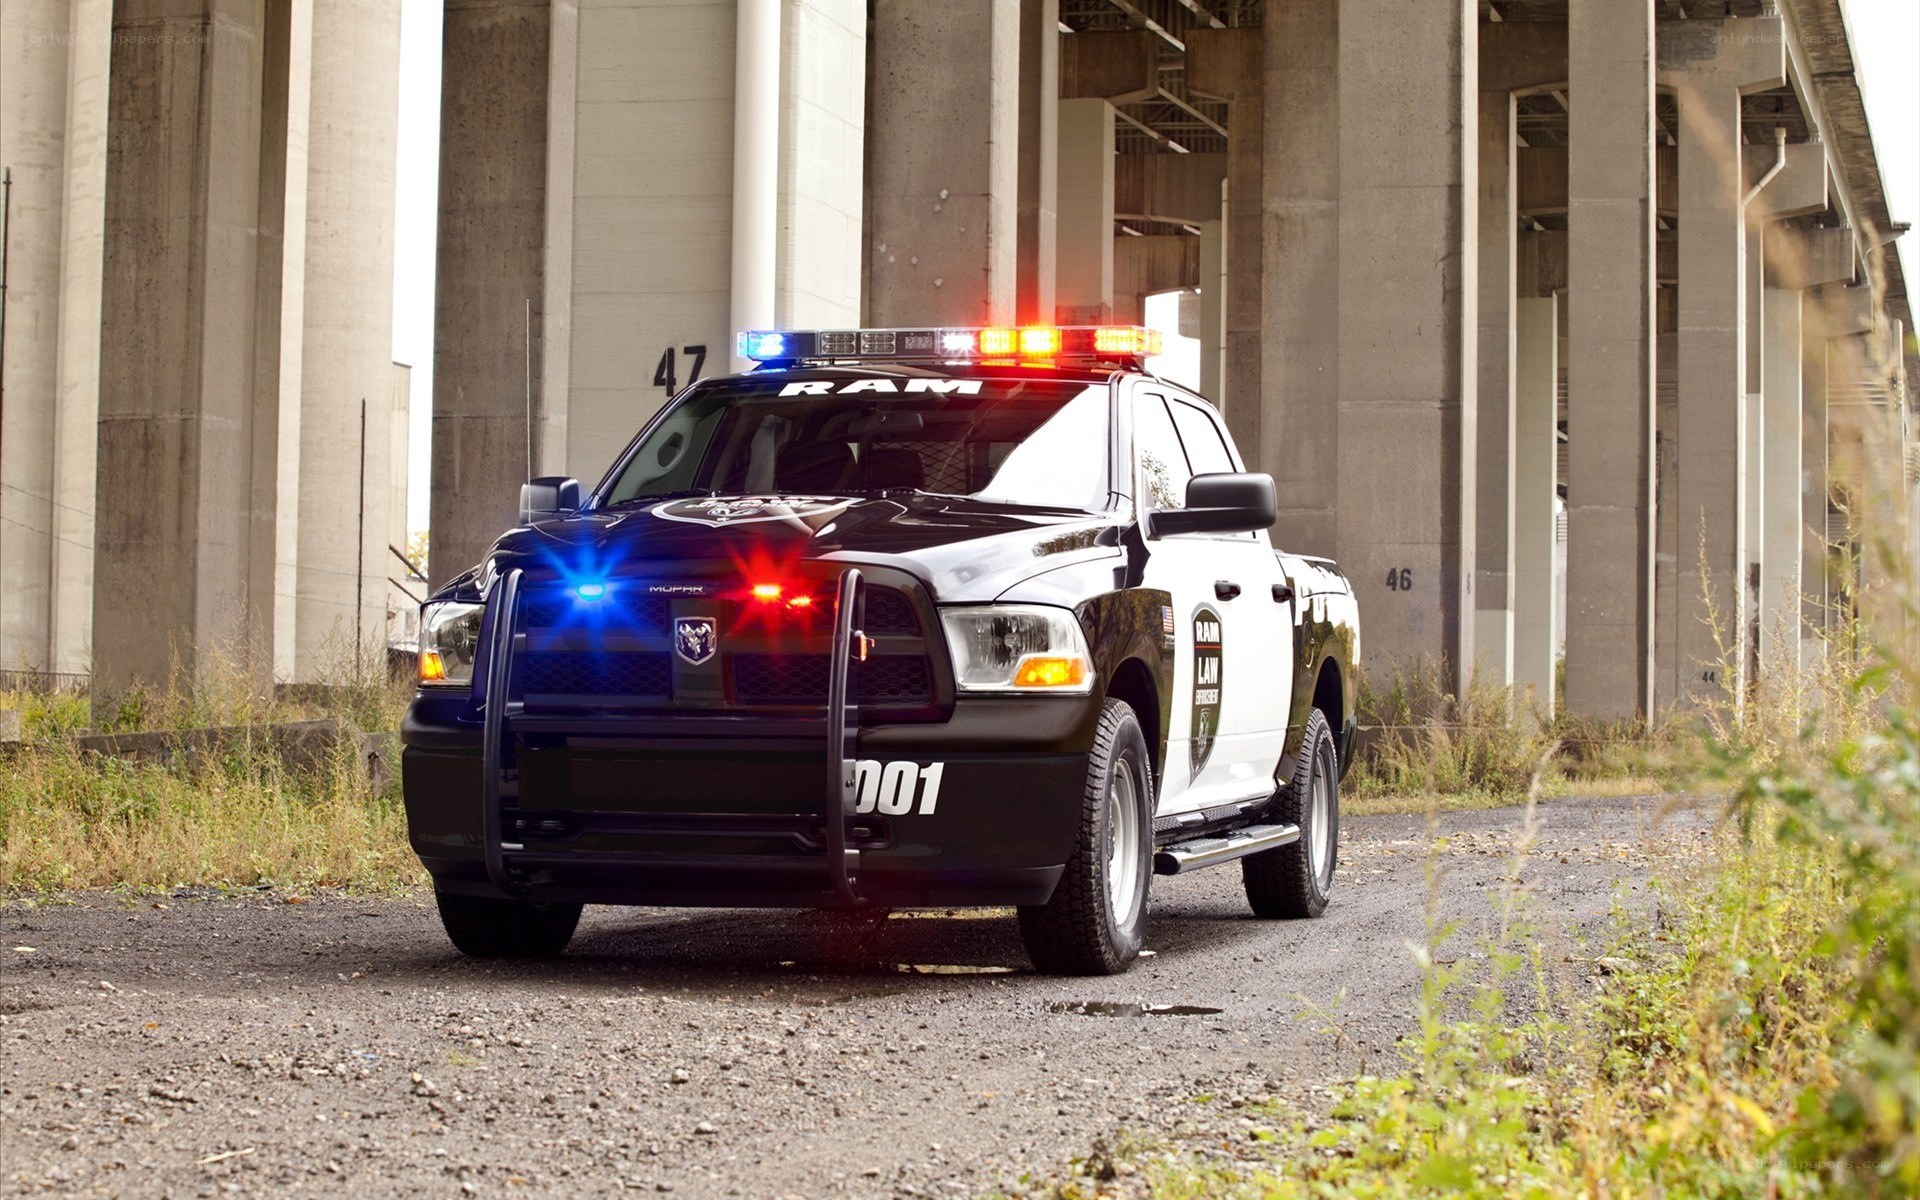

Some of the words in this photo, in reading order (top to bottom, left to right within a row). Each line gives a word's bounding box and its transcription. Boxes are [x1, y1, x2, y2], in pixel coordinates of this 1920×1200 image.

[653, 345, 707, 397] 47
[778, 378, 983, 397] RAM
[1386, 567, 1413, 592] 46
[1195, 620, 1220, 643] RAM
[1197, 656, 1219, 685] LAW
[1702, 671, 1715, 684] 44
[855, 759, 945, 816] 001
